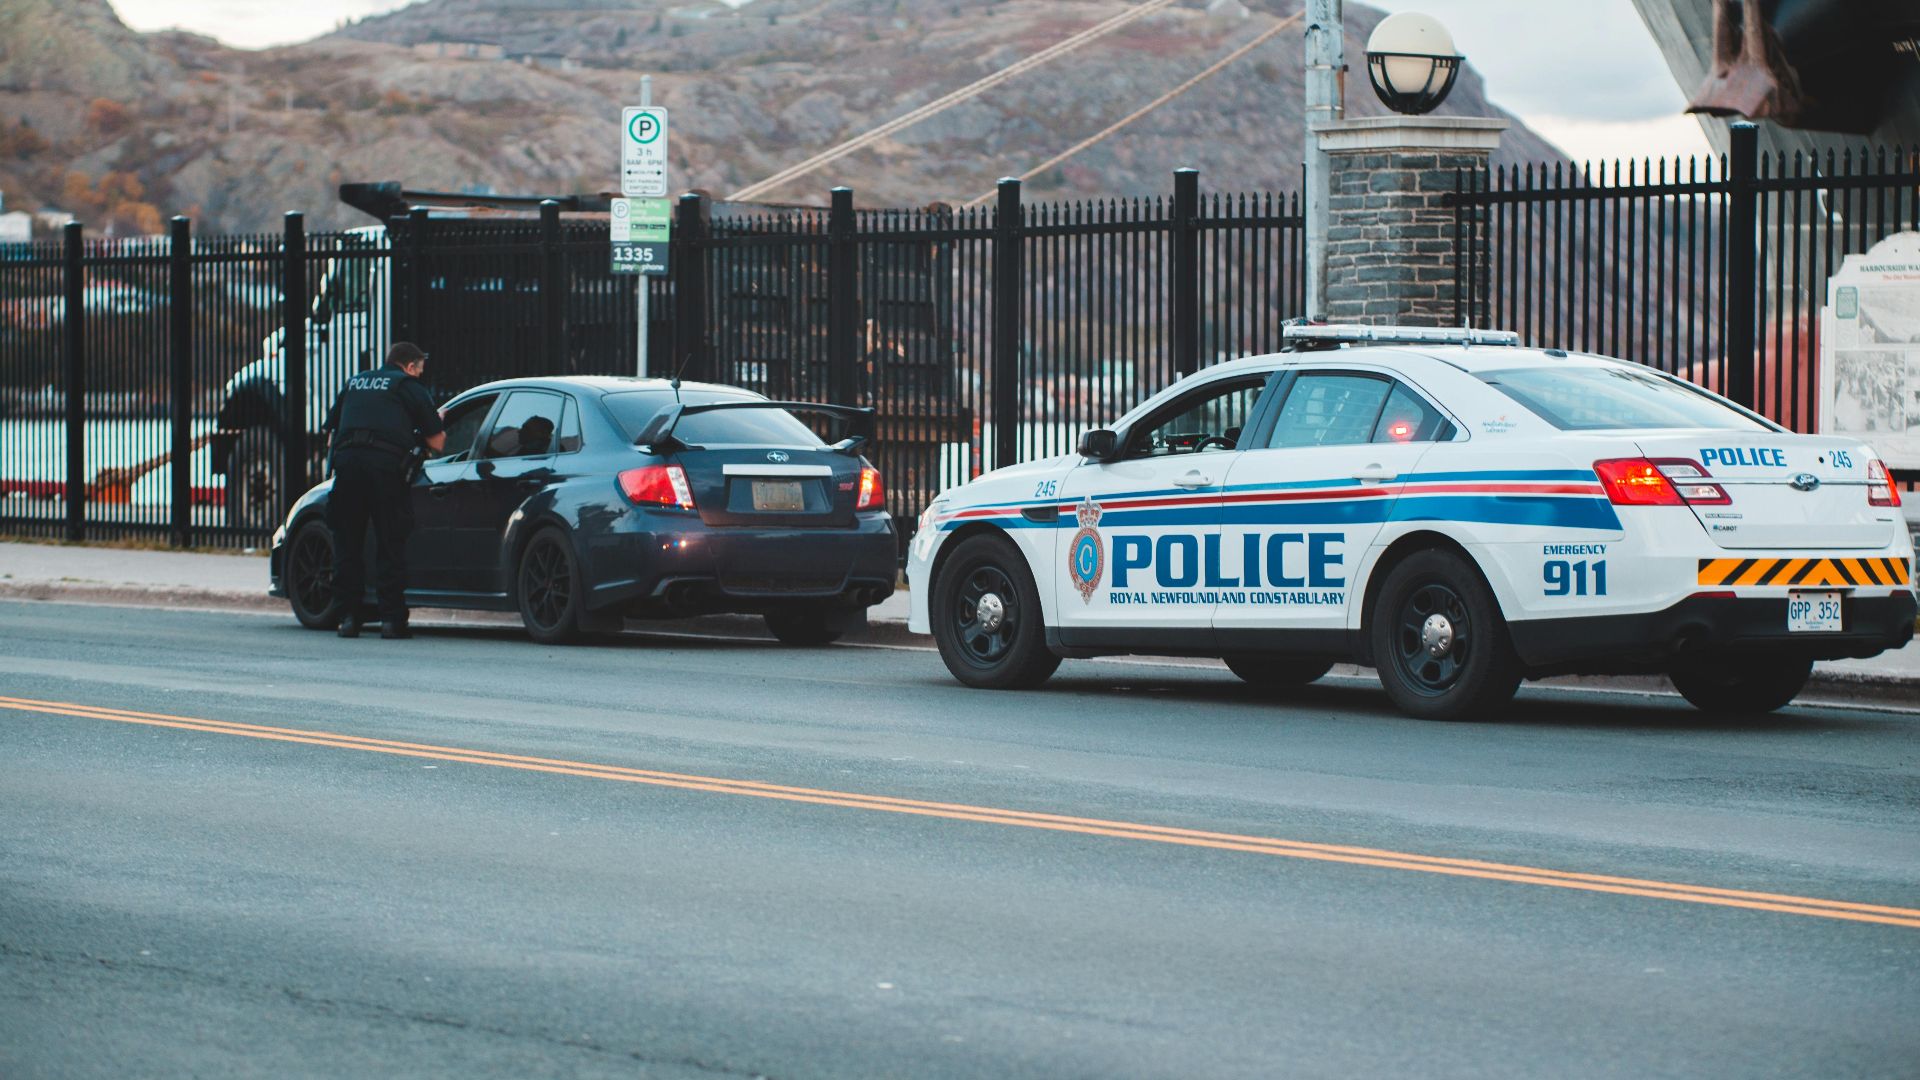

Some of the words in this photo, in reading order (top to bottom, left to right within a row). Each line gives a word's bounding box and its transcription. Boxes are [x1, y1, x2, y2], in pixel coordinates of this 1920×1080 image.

[640, 121, 651, 136] P
[613, 247, 653, 261] 1335
[349, 377, 391, 391] POLICE
[1699, 447, 1788, 467] POLICE
[1829, 450, 1853, 469] 245
[1034, 480, 1057, 498] 245
[1543, 545, 1607, 555] EMERGENCY
[1111, 532, 1346, 588] POLICE
[1543, 560, 1607, 596] 911
[1110, 592, 1148, 605] ROYAL
[1150, 592, 1246, 605] NEWFOUNDLAND
[1250, 592, 1345, 605] CONSTABULARY
[1790, 601, 1811, 620] GPP
[1818, 601, 1840, 620] 352
